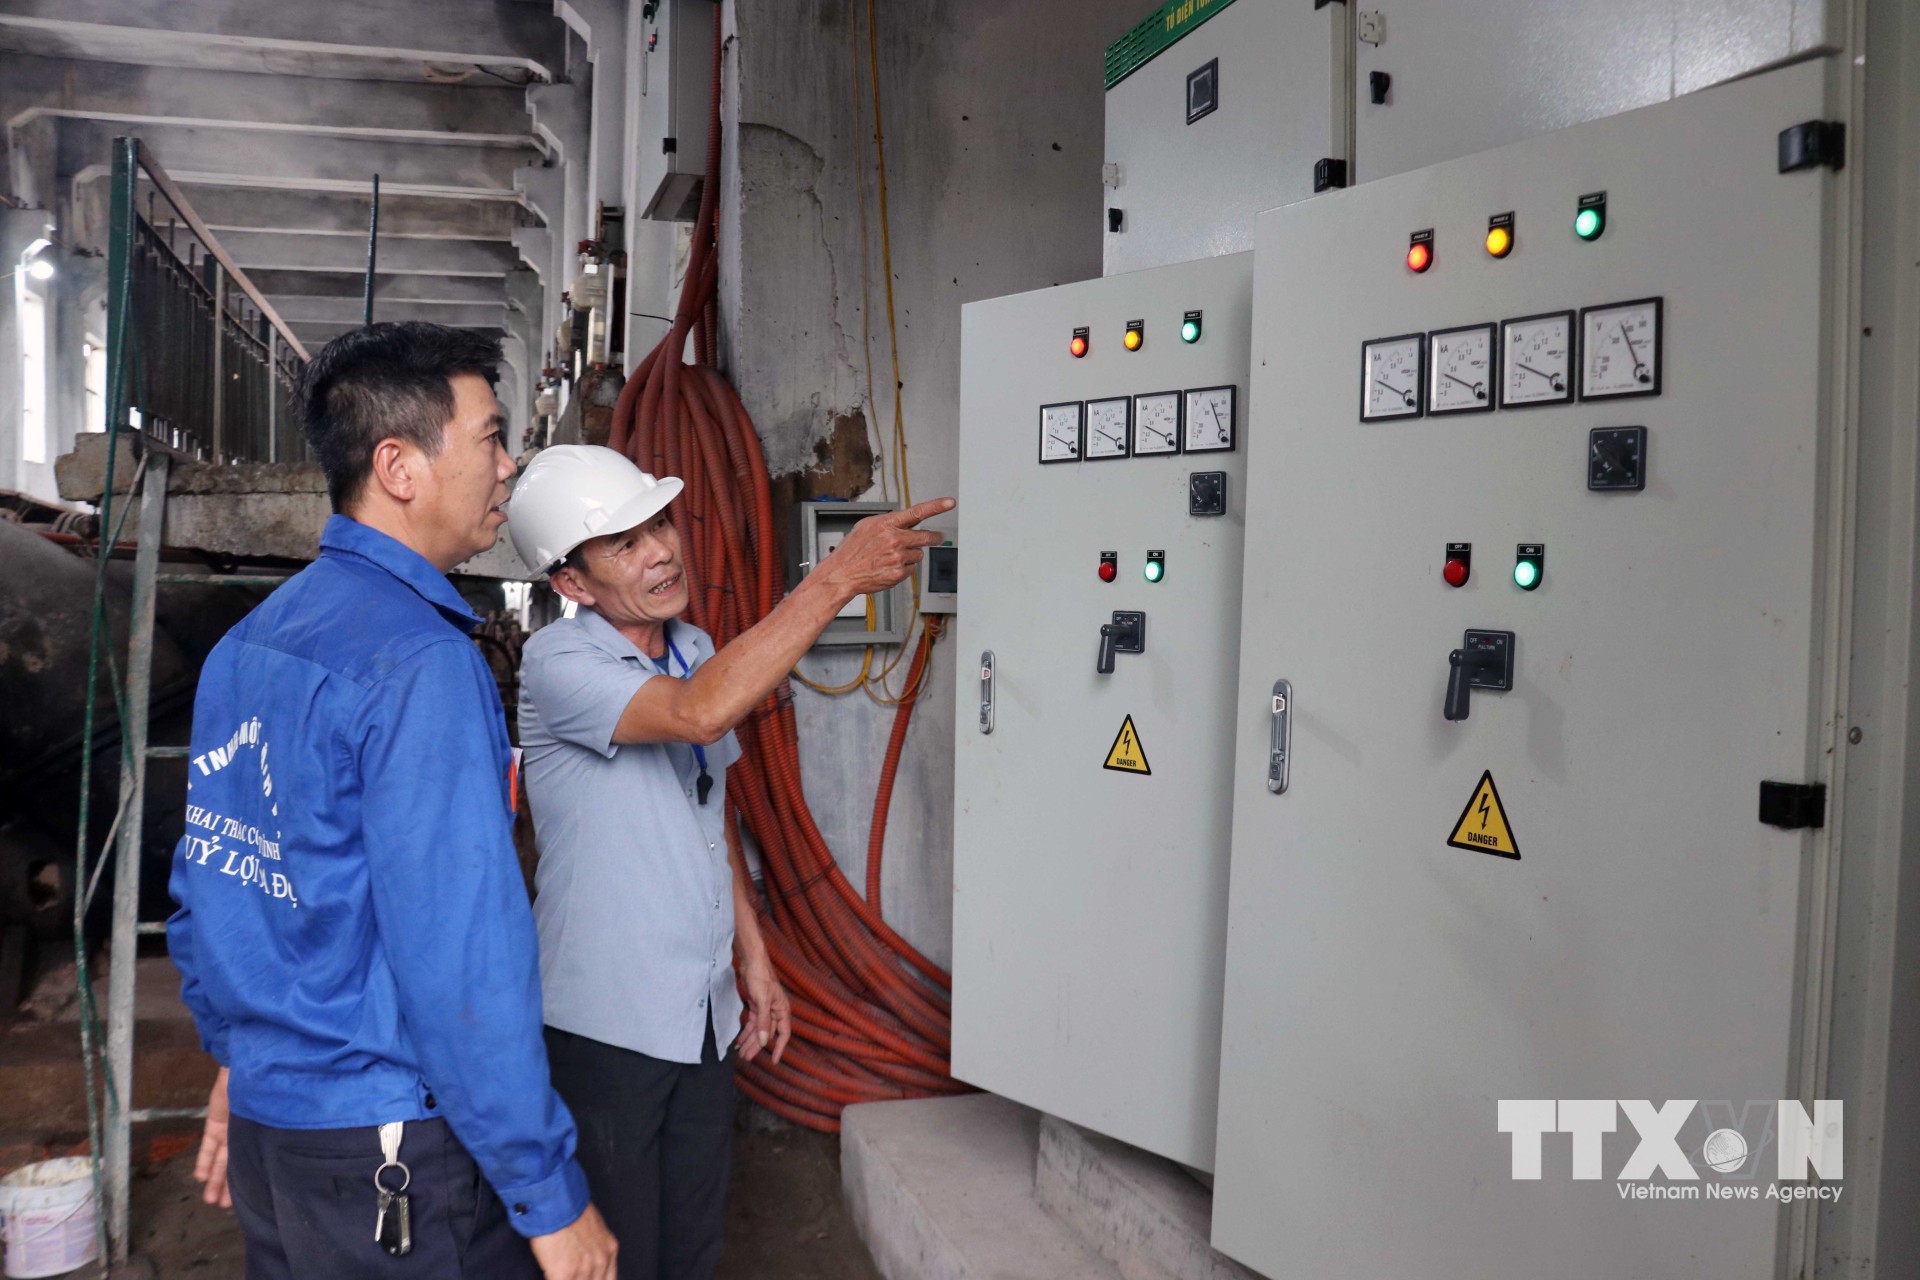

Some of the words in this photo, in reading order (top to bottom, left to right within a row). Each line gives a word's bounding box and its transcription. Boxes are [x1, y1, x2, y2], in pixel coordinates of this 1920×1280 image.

[1513, 333, 1522, 343] kA
[1440, 344, 1448, 354] kA
[1116, 757, 1137, 767] DANGER
[1467, 831, 1498, 847] DANGER
